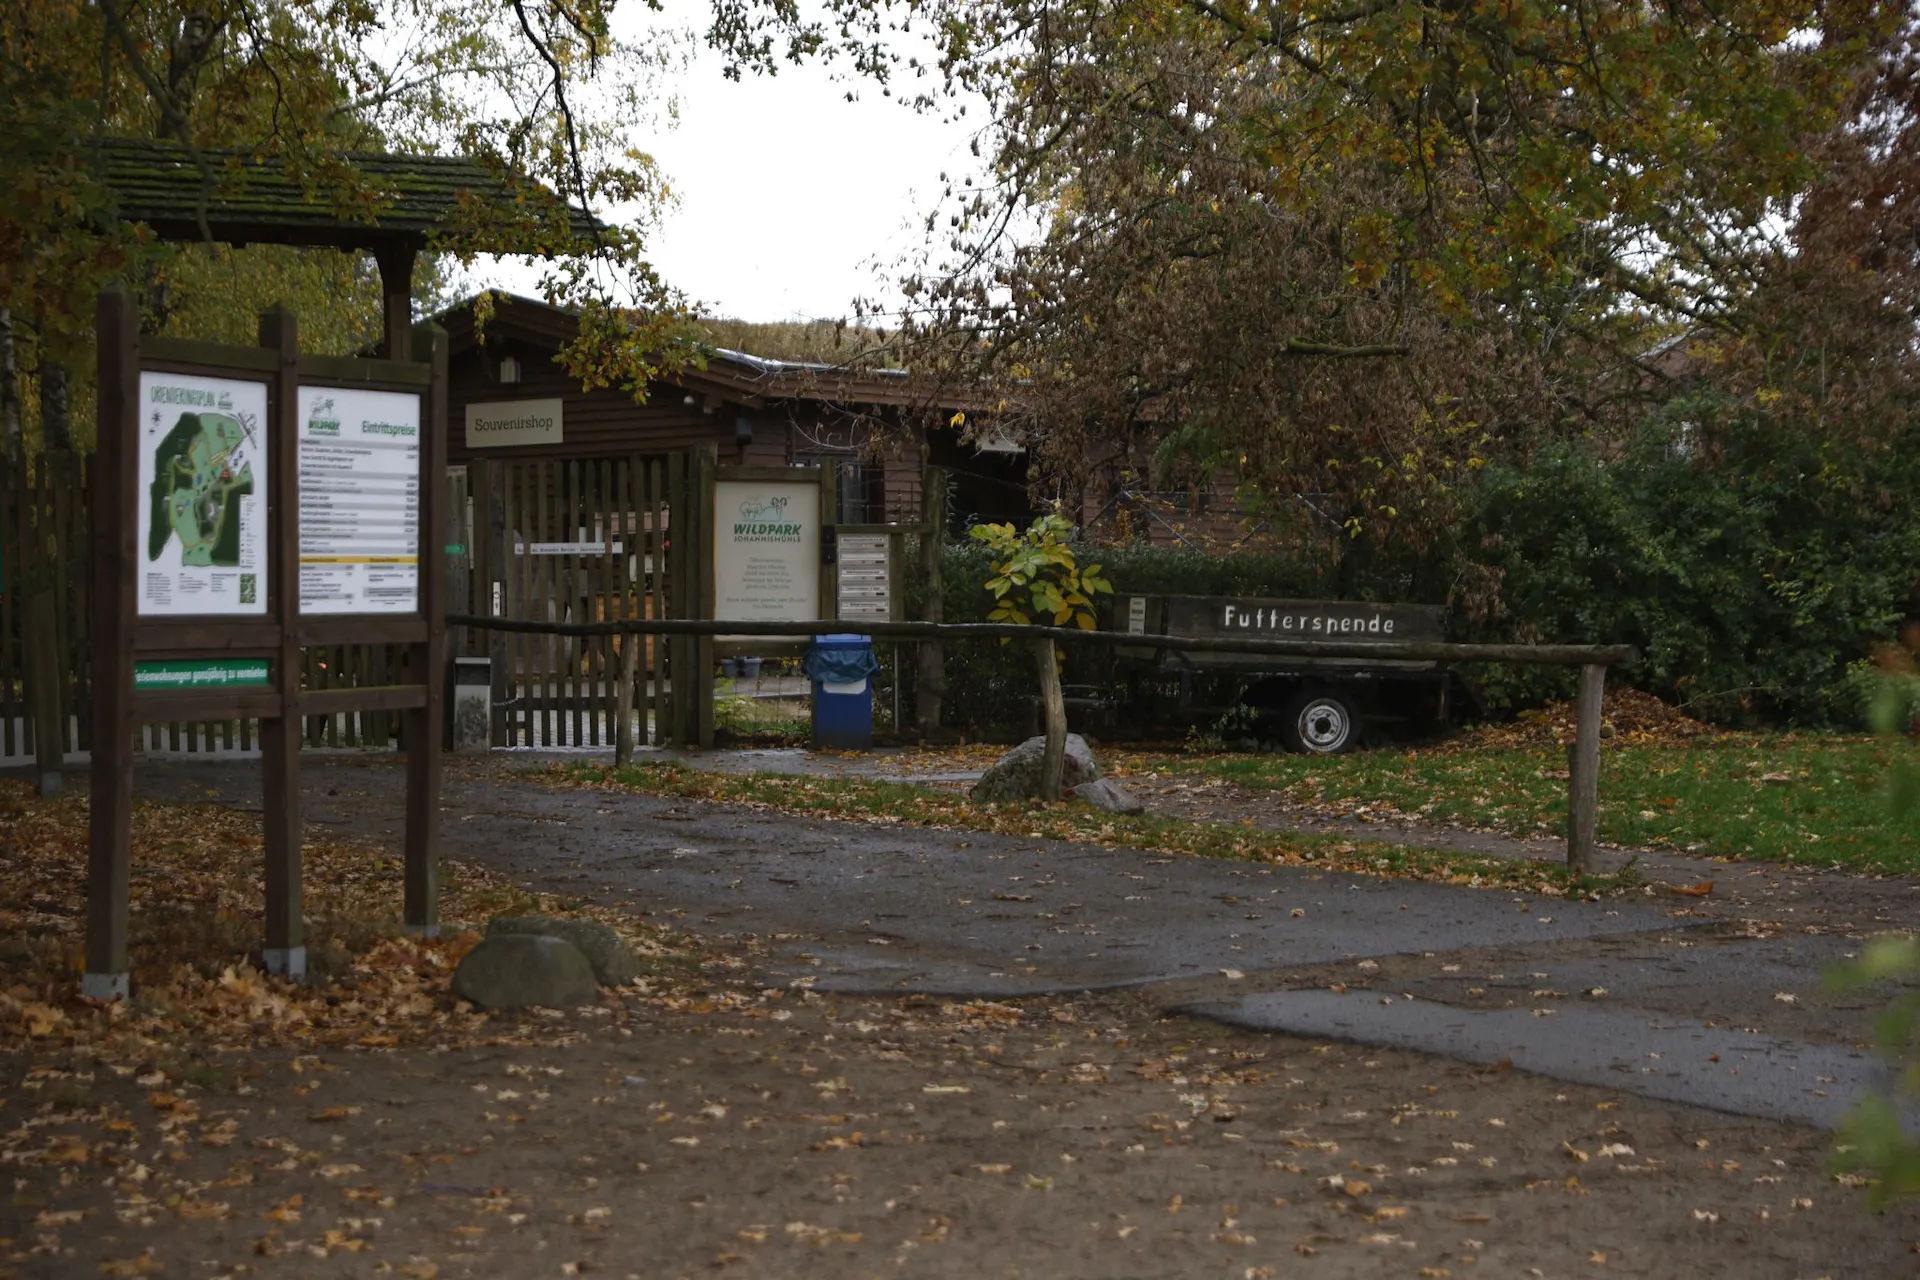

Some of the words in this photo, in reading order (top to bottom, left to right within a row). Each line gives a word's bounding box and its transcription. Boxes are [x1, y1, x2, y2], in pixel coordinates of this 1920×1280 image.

[362, 420, 416, 437] Eintrittspreise
[474, 415, 553, 432] Souvenirshop
[734, 523, 802, 535] WILDPARK
[1225, 605, 1394, 635] Futterspende
